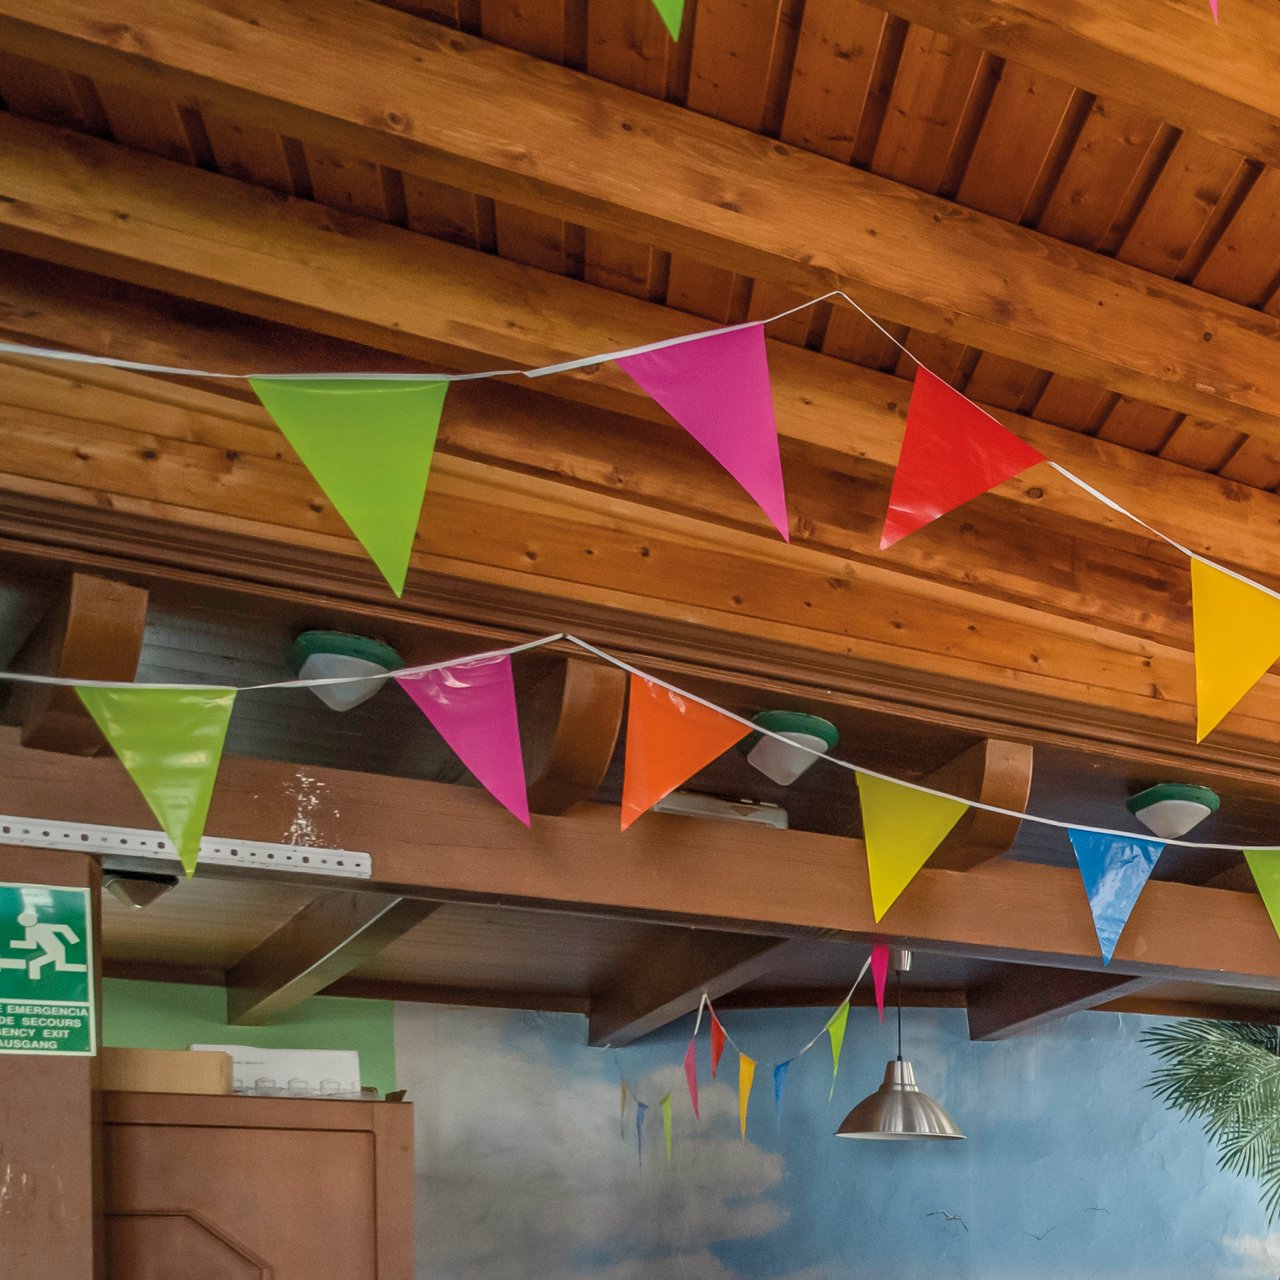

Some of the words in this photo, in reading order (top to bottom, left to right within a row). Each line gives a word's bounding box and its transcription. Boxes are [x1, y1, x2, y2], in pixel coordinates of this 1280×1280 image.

[6, 1004, 89, 1017] EMERGENCIA
[21, 1017, 82, 1028] SECOURS
[0, 1027, 36, 1037] ENCY
[43, 1029, 71, 1039] EXIT
